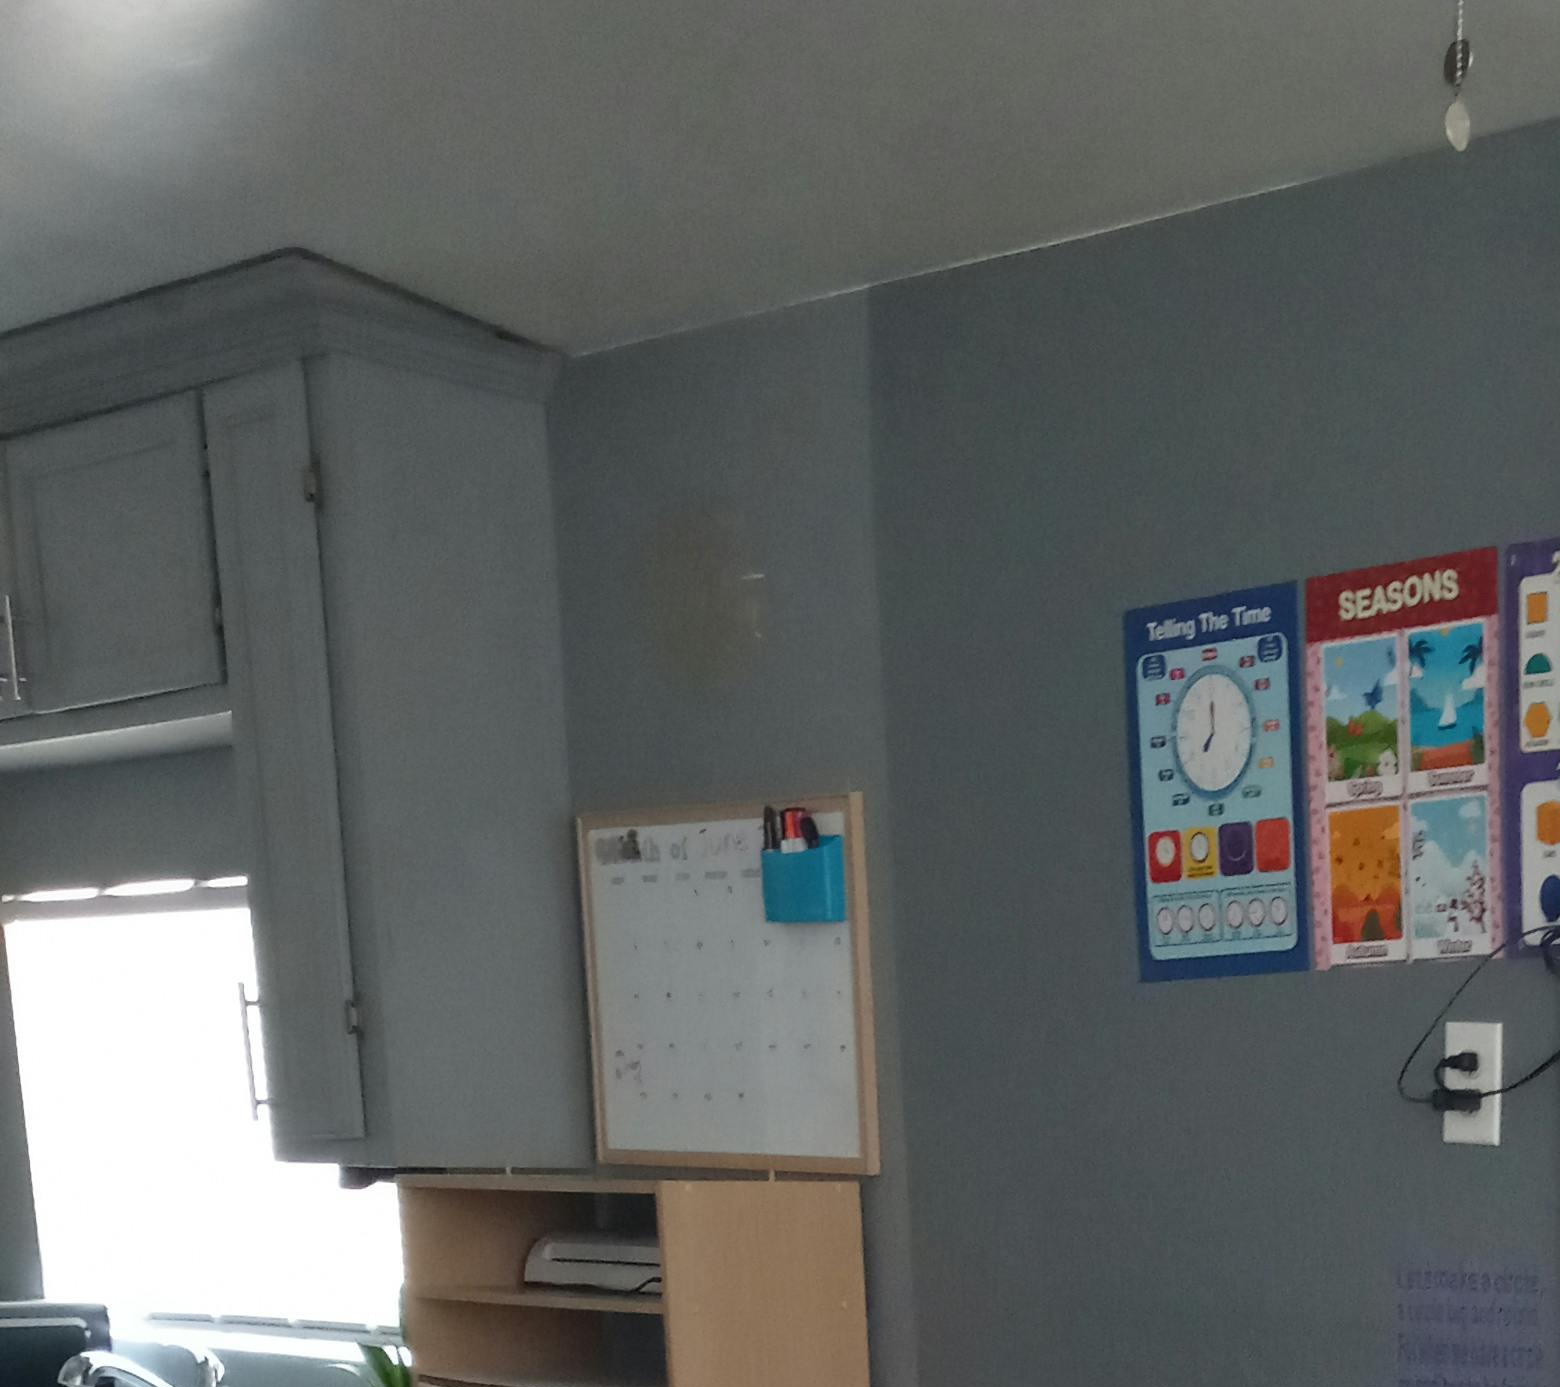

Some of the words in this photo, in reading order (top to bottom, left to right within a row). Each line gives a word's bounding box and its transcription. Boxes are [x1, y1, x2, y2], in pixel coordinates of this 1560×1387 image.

[1338, 568, 1460, 621] SEASONS
[1146, 618, 1197, 642] Telling
[1198, 611, 1230, 633] The
[1231, 605, 1272, 627] Time
